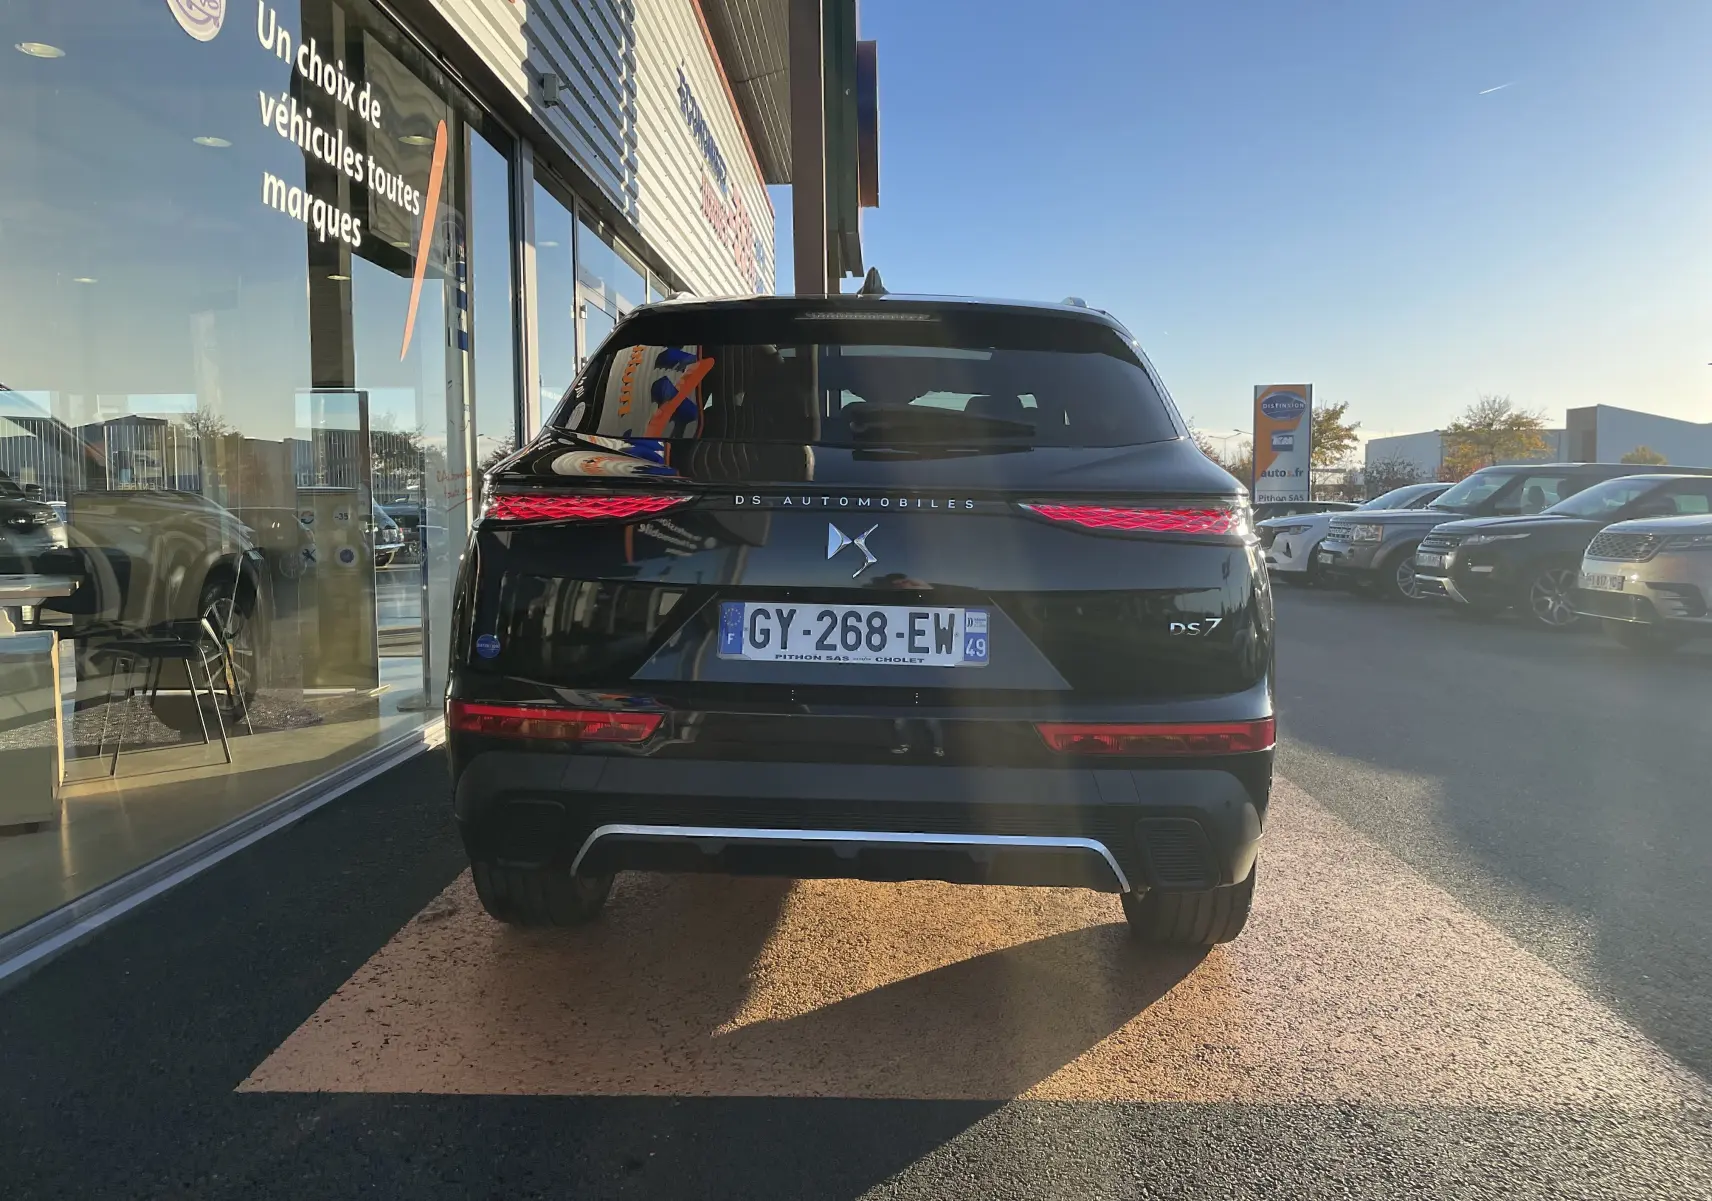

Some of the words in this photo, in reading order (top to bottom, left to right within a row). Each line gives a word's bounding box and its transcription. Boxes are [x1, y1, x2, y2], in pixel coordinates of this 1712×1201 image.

[257, 0, 291, 64] Un
[297, 37, 355, 111] choix
[358, 82, 381, 129] de
[259, 90, 363, 182] véhicules
[367, 155, 420, 216] toutes
[262, 171, 361, 248] marques
[1260, 467, 1304, 478] autos.fr
[735, 495, 761, 505] DS
[783, 496, 974, 509] AUTOMOBILES
[1258, 494, 1287, 502] Pithon
[1288, 494, 1304, 502] SAS
[727, 633, 735, 645] F
[749, 608, 955, 654] GY-268-EW
[966, 638, 986, 657] 49
[875, 656, 925, 664] CHOLET
